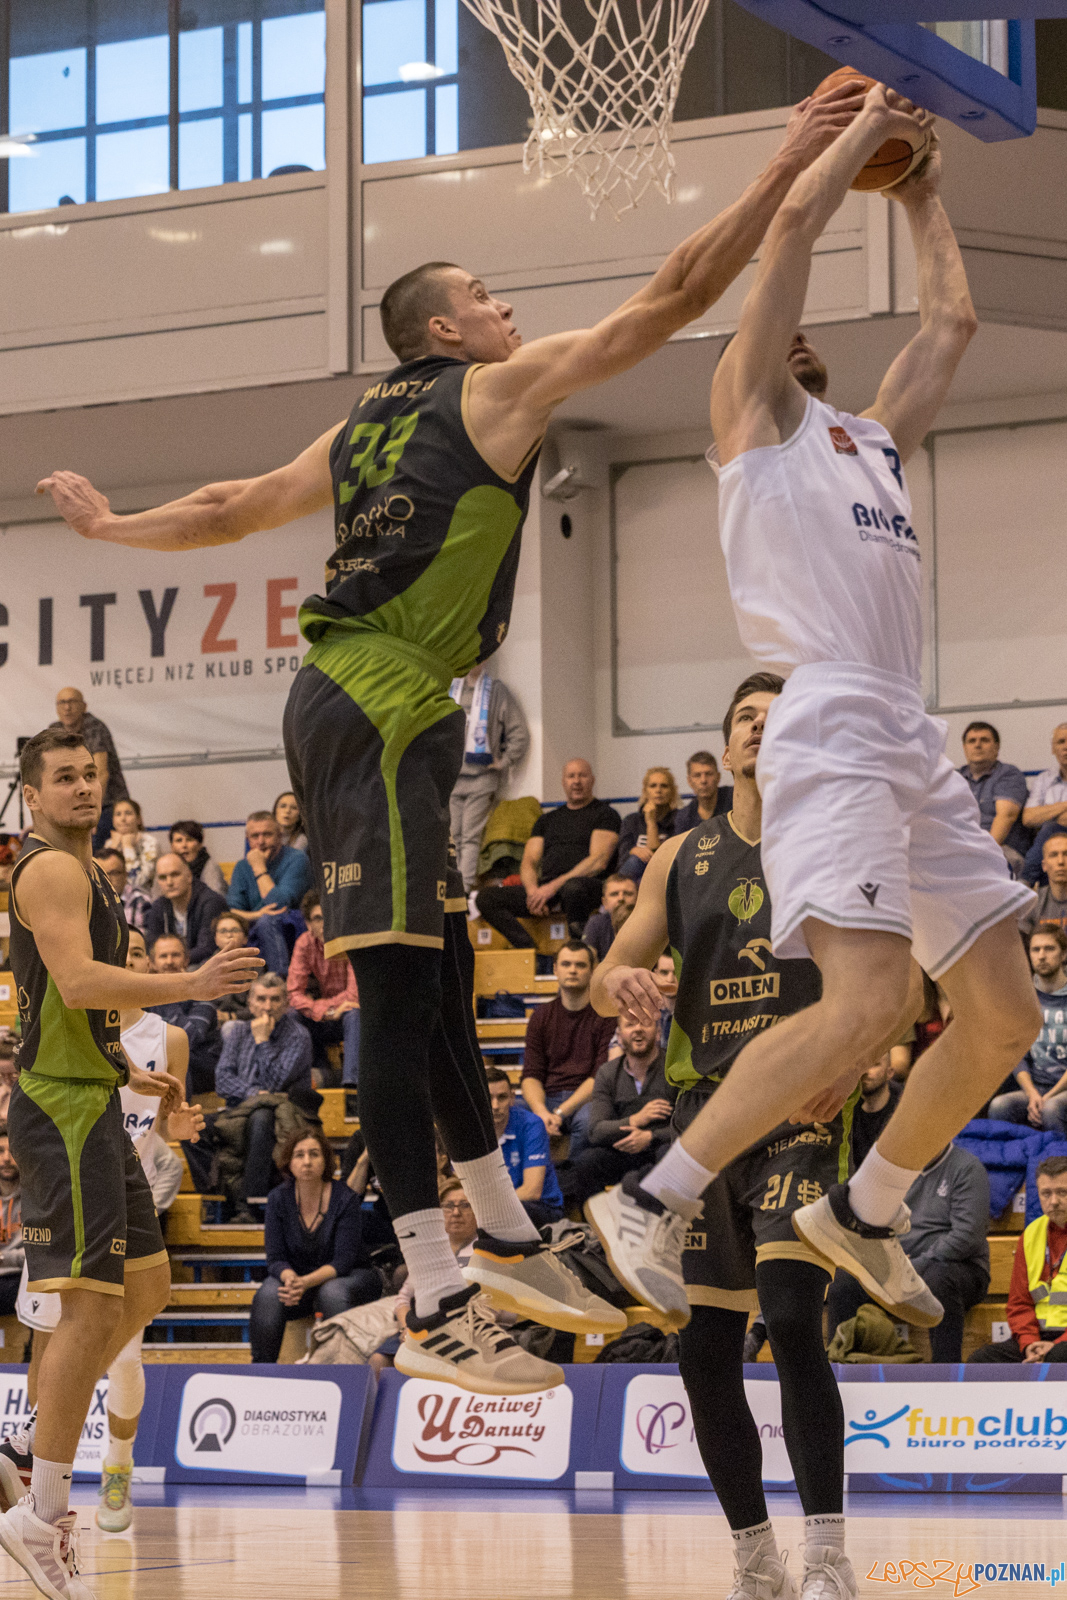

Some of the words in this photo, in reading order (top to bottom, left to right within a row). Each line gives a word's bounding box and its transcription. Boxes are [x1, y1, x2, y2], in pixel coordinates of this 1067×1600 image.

[0, 577, 298, 669] ITYZE
[90, 666, 154, 688] WIĘCEJ
[165, 661, 195, 682] NIŻ
[205, 659, 253, 678] KLUB
[713, 976, 774, 1001] ORLEN
[760, 1171, 794, 1211] 21
[22, 1227, 52, 1242] EVEND
[243, 1410, 327, 1422] DIAGNOSTYKA
[465, 1395, 543, 1418] leniwej
[240, 1423, 325, 1437] OBRAZOWA
[458, 1415, 546, 1442] Danuty
[906, 1408, 1067, 1436] funclub
[906, 1438, 966, 1449] biuro
[973, 1437, 1067, 1451] podróży
